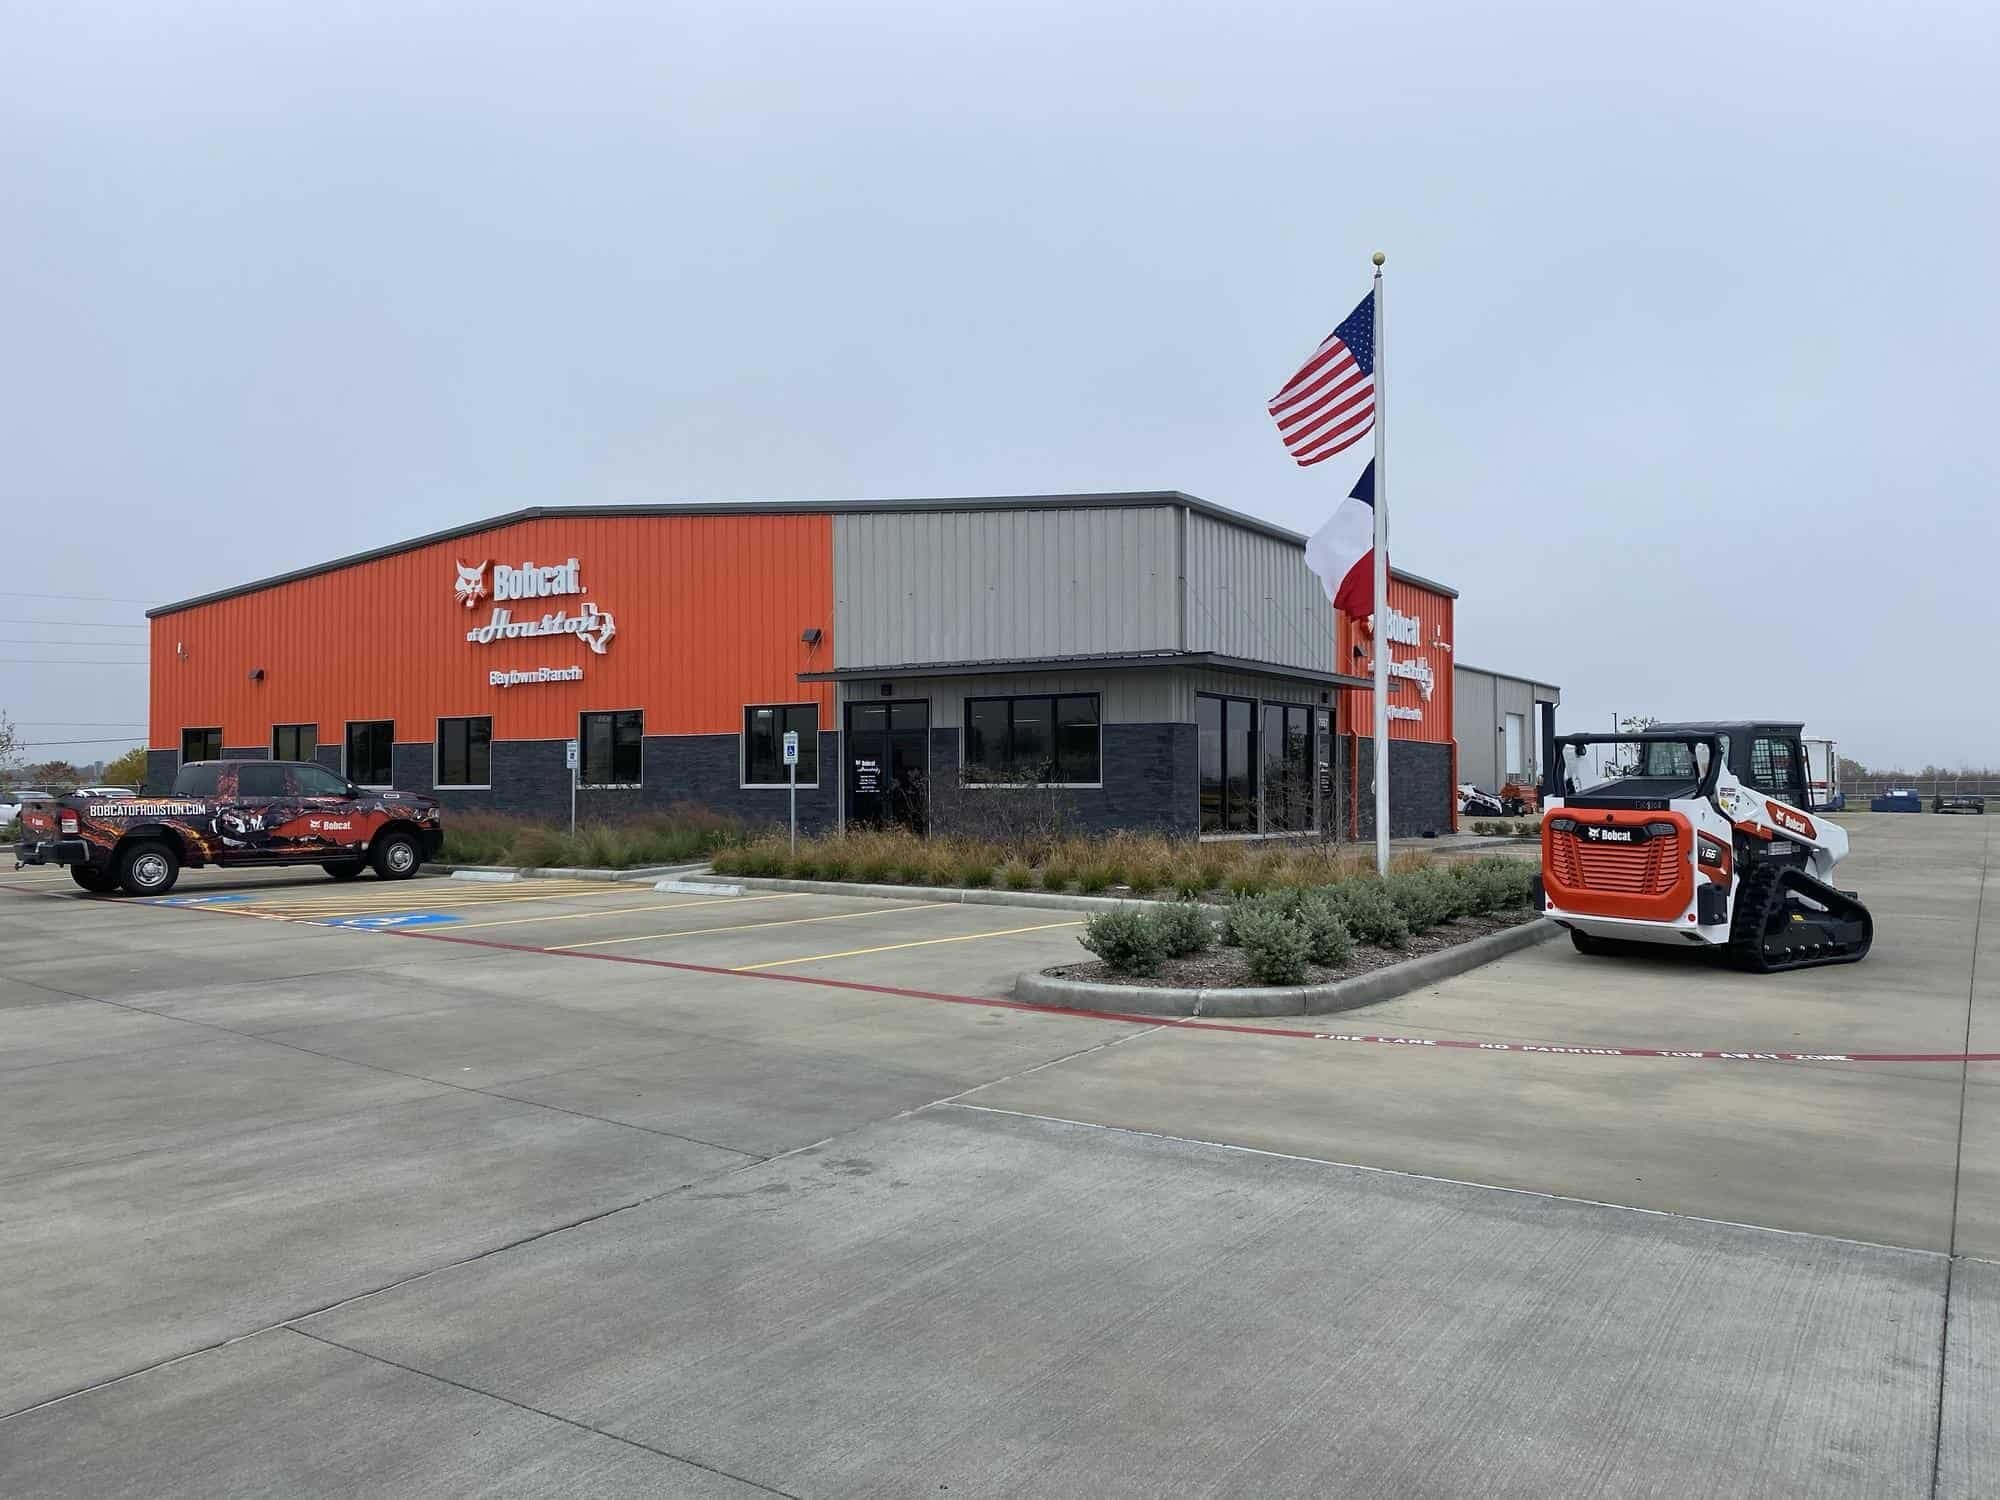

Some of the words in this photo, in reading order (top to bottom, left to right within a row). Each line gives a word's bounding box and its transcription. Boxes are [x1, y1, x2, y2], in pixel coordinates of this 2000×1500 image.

[466, 627, 481, 641] of
[480, 608, 599, 644] Houston
[490, 669, 539, 687] Baytown
[539, 666, 583, 681] Branch
[90, 803, 206, 817] BOBCATOFHOUSTON.COM
[323, 821, 351, 831] Bobcat
[1601, 829, 1631, 841] Bobcat
[1378, 1038, 1438, 1047] LANE
[1523, 1046, 1622, 1056] PARKING
